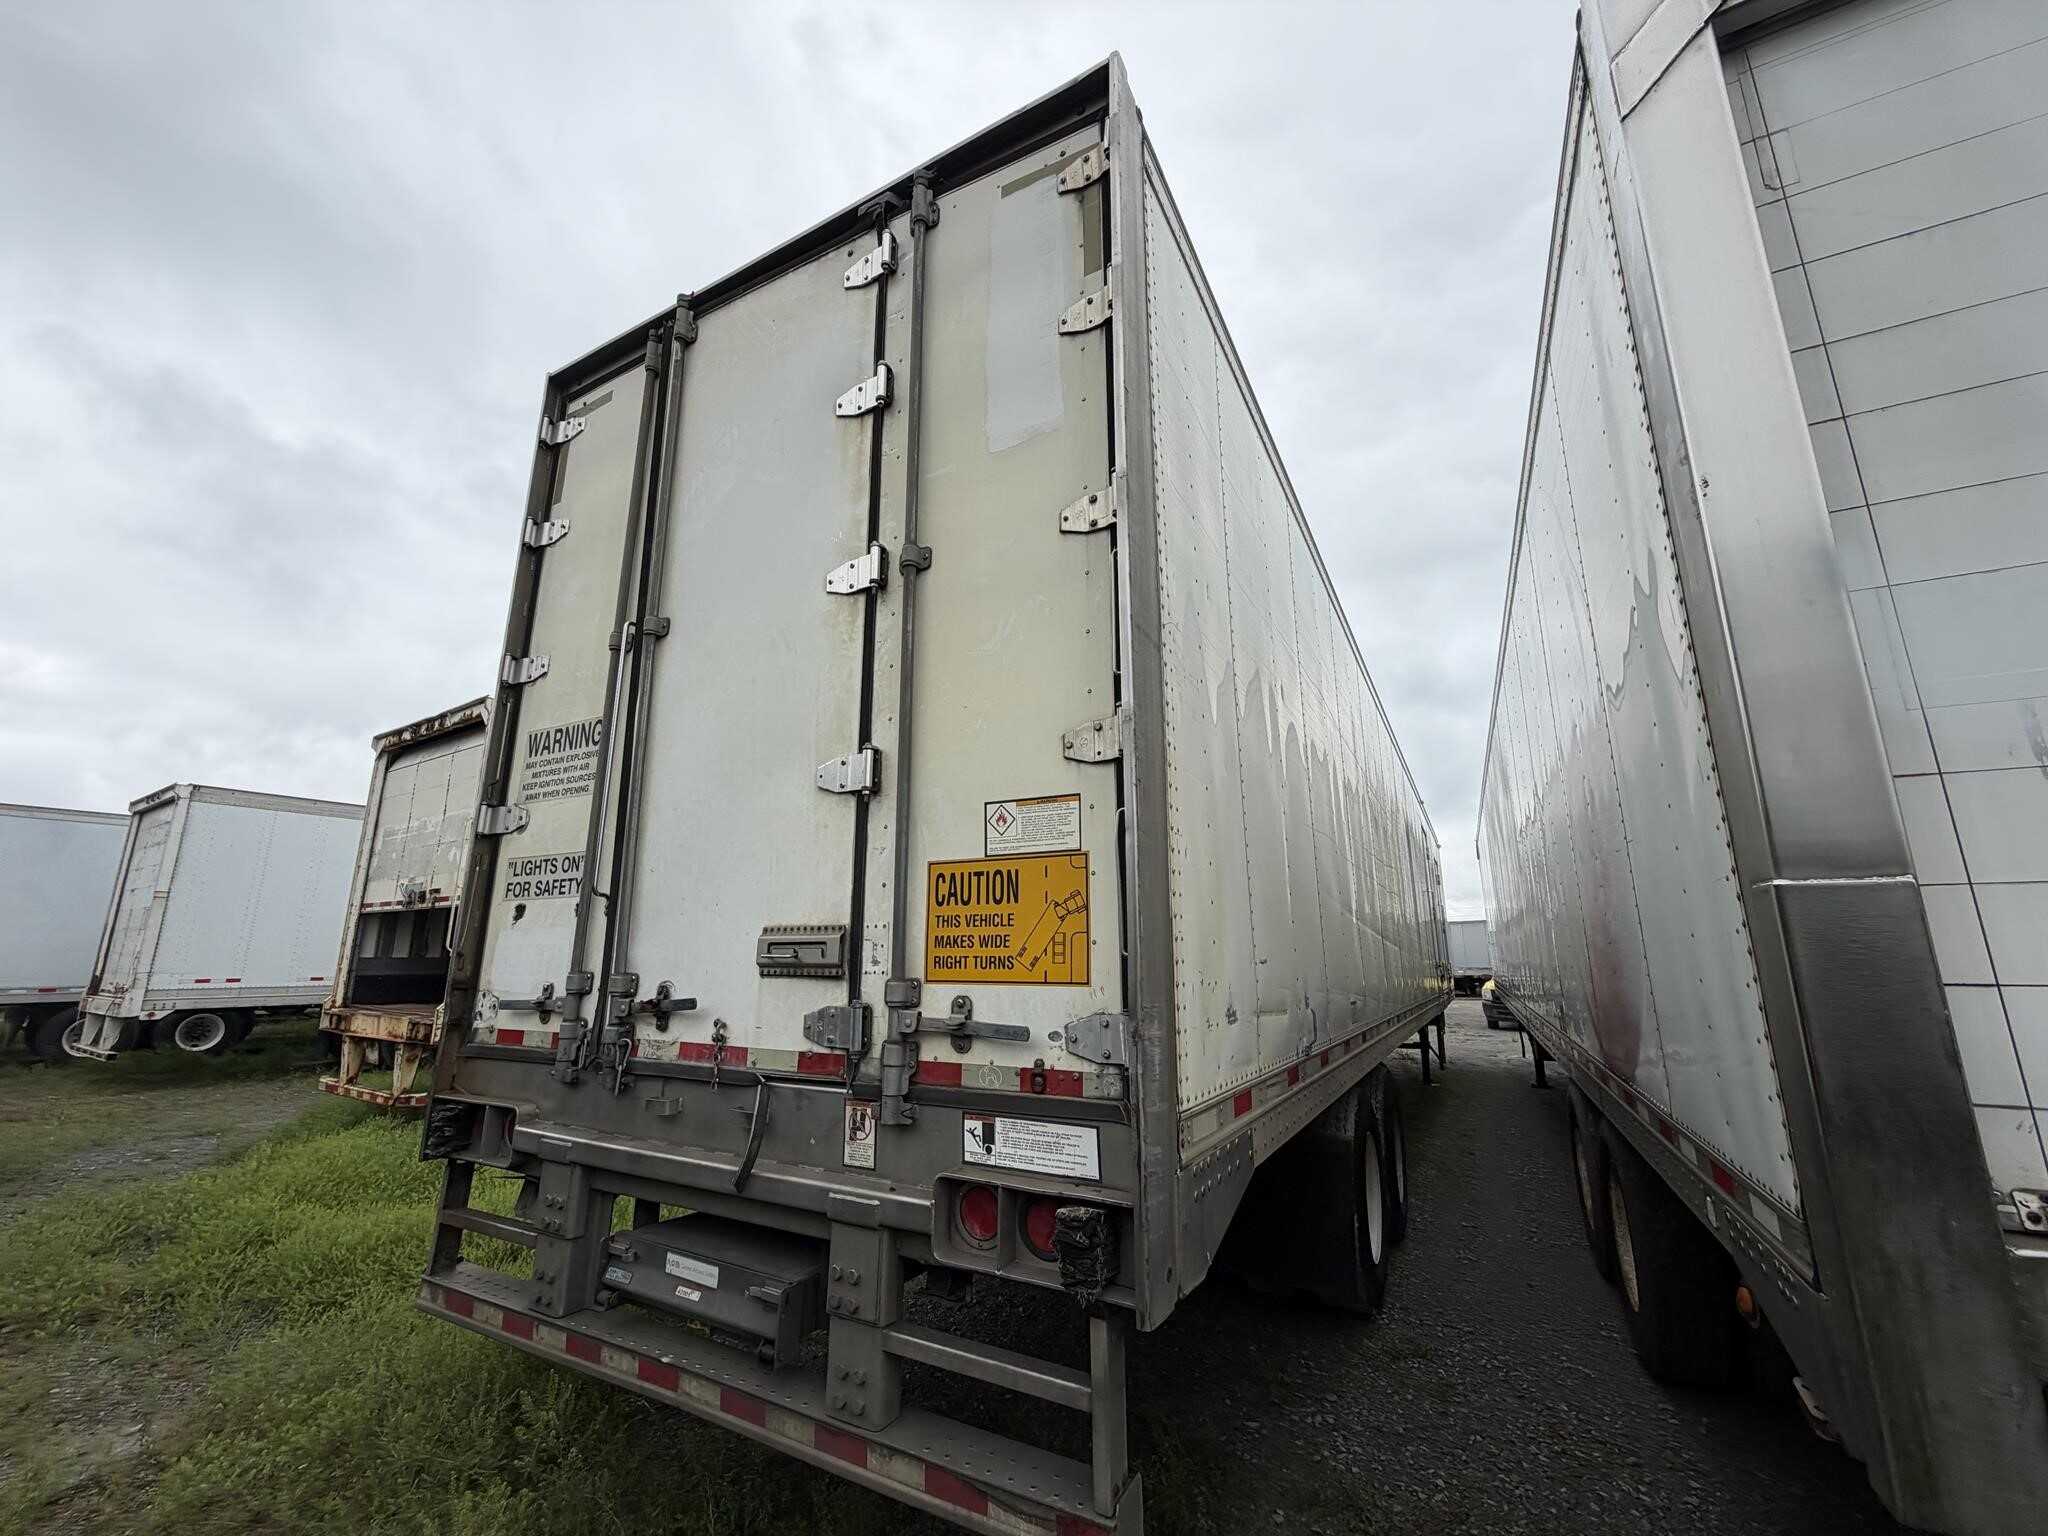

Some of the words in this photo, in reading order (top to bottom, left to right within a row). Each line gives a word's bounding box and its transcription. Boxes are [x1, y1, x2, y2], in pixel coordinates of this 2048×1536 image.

[528, 719, 603, 758] WARNING
[526, 760, 538, 770] MAY
[539, 755, 565, 768] CONTAIN
[565, 749, 600, 763] EXPLOSIVE
[531, 767, 562, 779] MIXTURES
[563, 764, 578, 775] WITH
[579, 762, 590, 772] AIR
[522, 781, 538, 791] KEEP
[538, 777, 565, 789] IGNITION
[566, 772, 596, 785] SOURCES
[525, 791, 541, 801] AWAY
[542, 788, 560, 798] WHEN
[561, 785, 590, 796] OPENING
[508, 858, 558, 877] "LIGHTS
[505, 881, 532, 899] FOR
[534, 878, 583, 897] SAFETY
[934, 868, 1019, 907] CAUTION
[935, 914, 961, 929] THIS
[965, 913, 1015, 928] VEHICLE
[934, 935, 974, 949] MAKES
[978, 934, 1010, 949] WIDE
[933, 955, 969, 970] RIGHT
[973, 955, 1015, 970] TURNS
